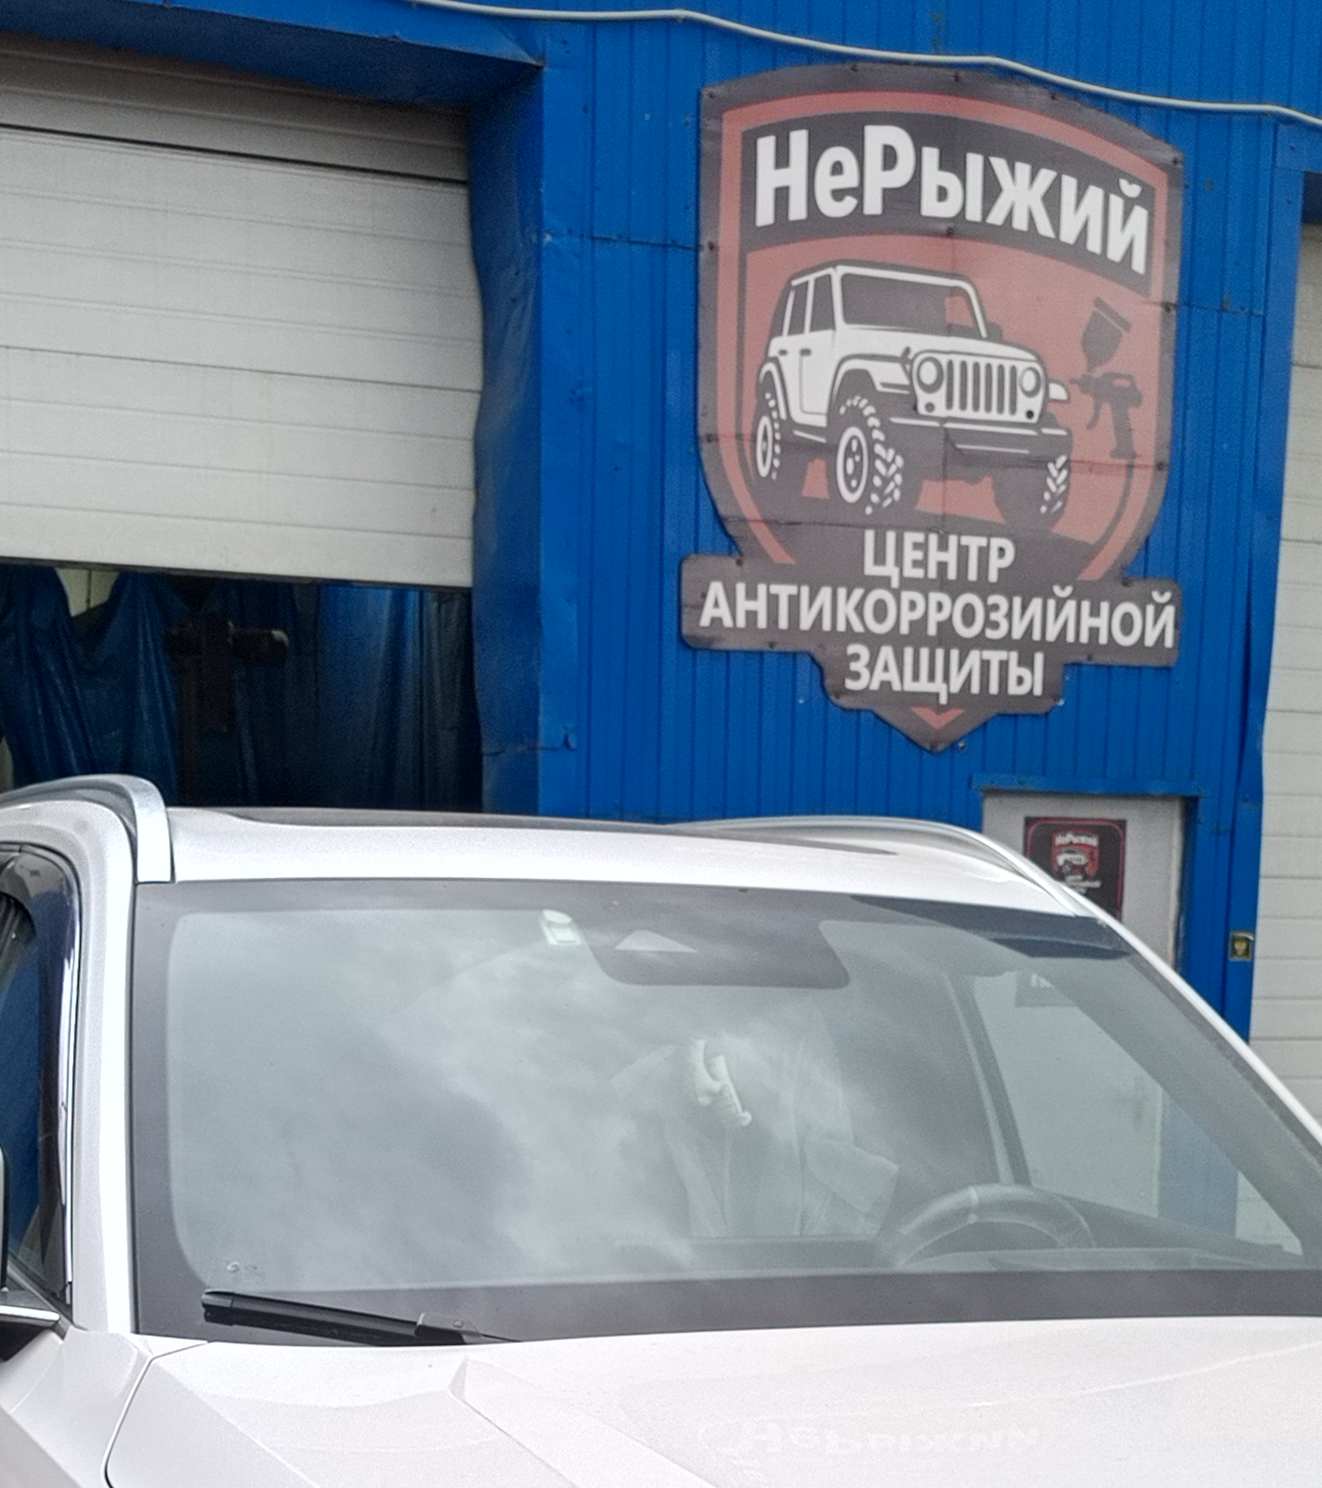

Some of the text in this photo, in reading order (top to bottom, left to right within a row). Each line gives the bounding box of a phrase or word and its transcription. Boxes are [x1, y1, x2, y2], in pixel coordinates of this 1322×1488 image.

[862, 529, 1016, 588] ЦЕНТР
[699, 582, 1175, 651] АНТИКОРРОЗИЙНОЙ
[844, 642, 1044, 704] ЗАЩИТЫ
